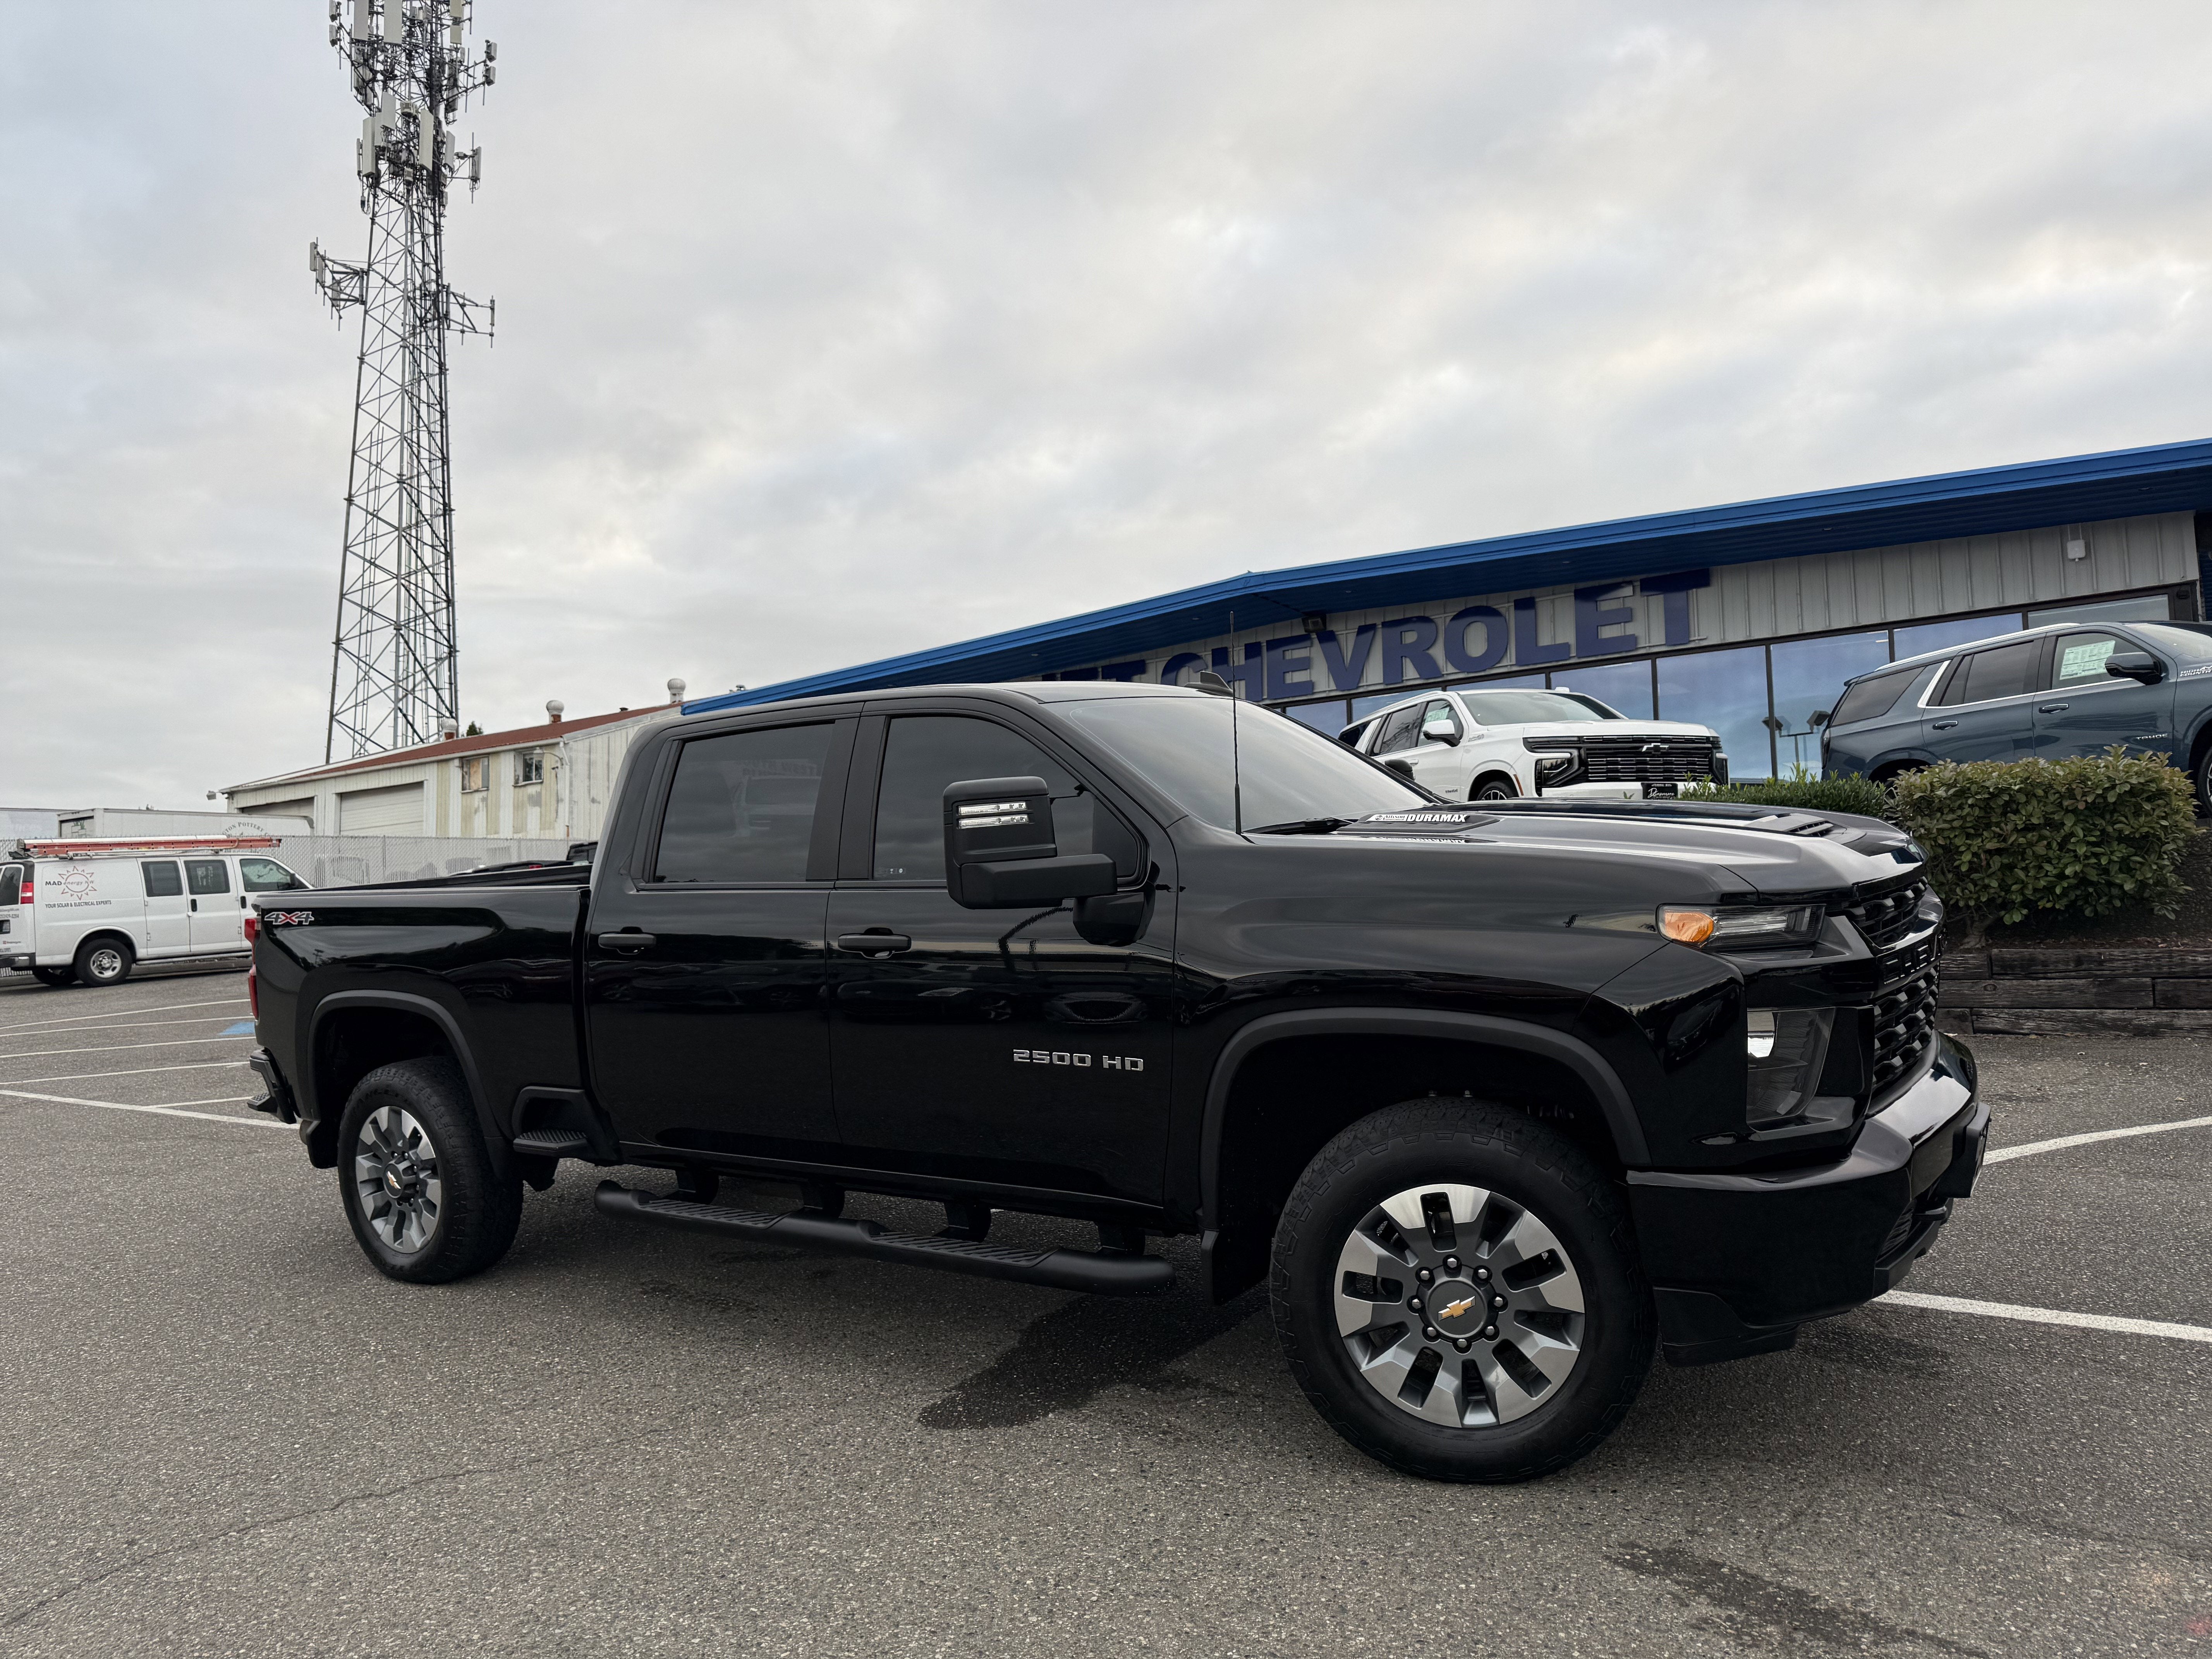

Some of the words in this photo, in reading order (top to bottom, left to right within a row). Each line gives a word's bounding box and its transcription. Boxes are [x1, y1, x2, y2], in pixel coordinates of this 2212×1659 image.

[1161, 568, 1710, 704] CHEVROLET
[1406, 814, 1468, 822] DURAMAX
[238, 822, 264, 832] POTTERY
[1013, 1049, 1091, 1066] 2500
[1103, 1055, 1144, 1071] HD
